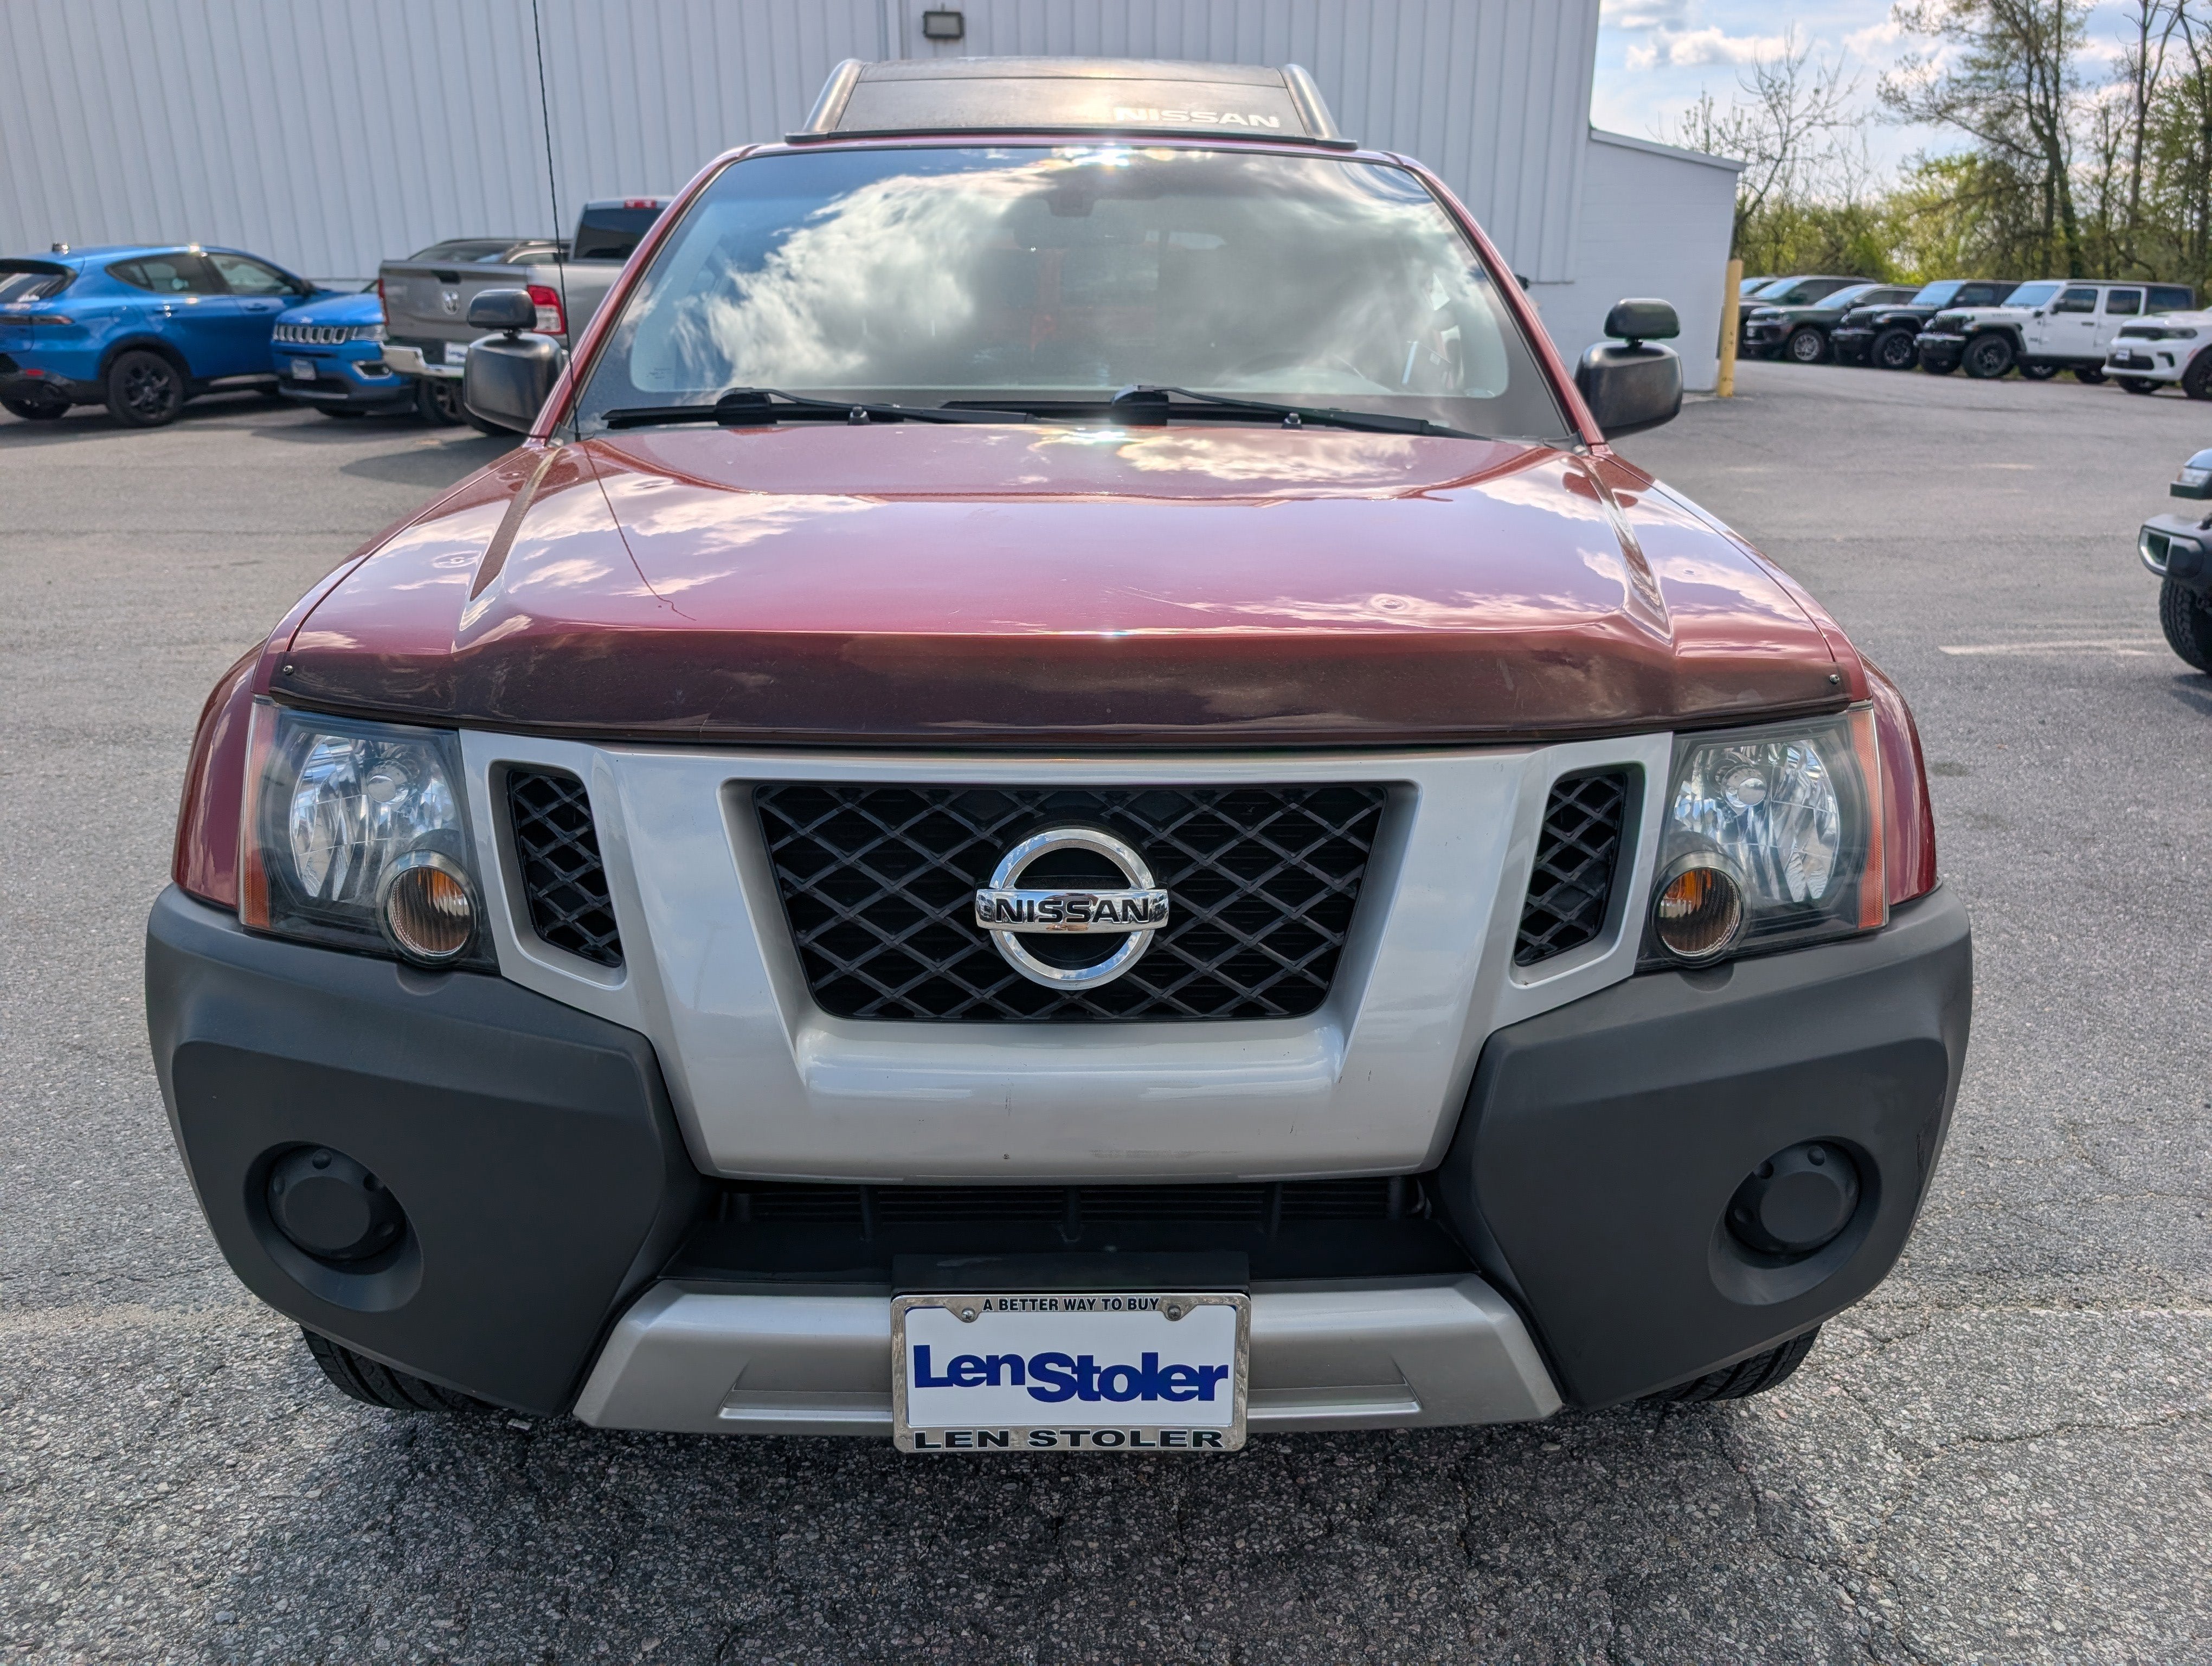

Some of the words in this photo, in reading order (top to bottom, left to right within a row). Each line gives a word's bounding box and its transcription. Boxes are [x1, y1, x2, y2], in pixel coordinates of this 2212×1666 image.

[1113, 107, 1279, 127] NISSAN
[995, 898, 1149, 924] NISSAN
[982, 1298, 994, 1311] A
[998, 1298, 1059, 1311] BETTER
[1063, 1297, 1097, 1311] WAY
[1101, 1297, 1123, 1310] TO
[1127, 1297, 1161, 1310] BUY
[914, 1430, 1010, 1449] LEN
[1027, 1430, 1226, 1449] STOLER
